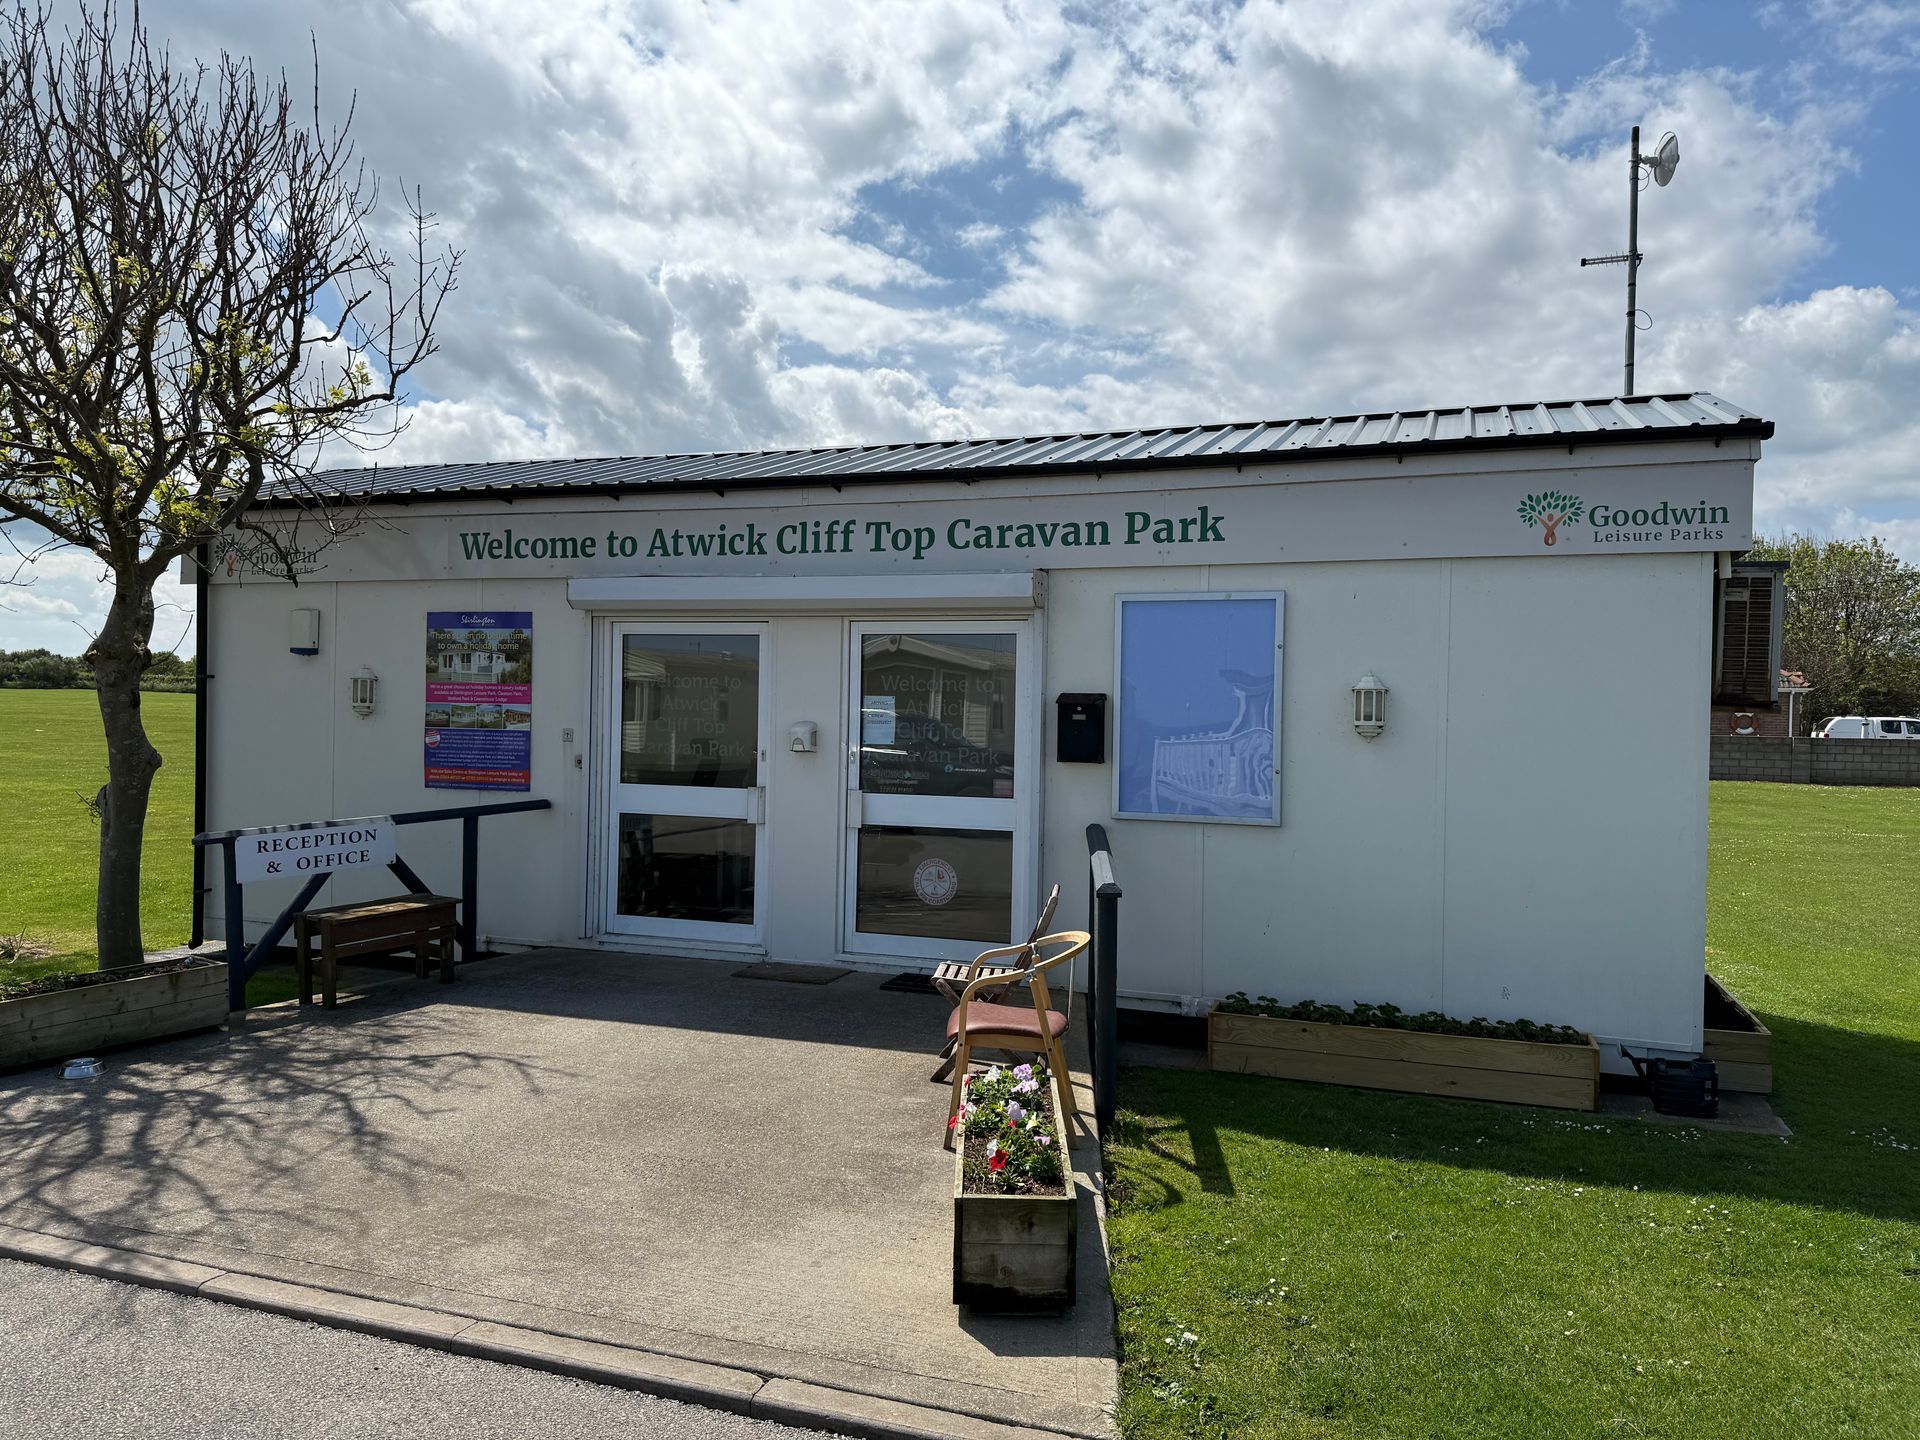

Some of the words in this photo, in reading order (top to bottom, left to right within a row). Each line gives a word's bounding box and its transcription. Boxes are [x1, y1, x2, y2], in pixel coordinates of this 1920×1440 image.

[1589, 500, 1730, 528] Goodwin
[460, 529, 596, 560] Welcome
[607, 530, 638, 558] to
[646, 524, 768, 558] Atwick
[776, 520, 857, 554] Cliff
[866, 520, 936, 560] Top
[947, 518, 1111, 550] Caravan
[1124, 505, 1226, 545] Park
[1593, 530, 1664, 544] Leisure
[1670, 527, 1724, 542] Parks
[288, 564, 314, 574] arks
[510, 632, 528, 640] time
[641, 673, 719, 688] elcome
[725, 675, 742, 689] to
[881, 675, 968, 692] Welcome
[976, 676, 994, 692] to
[693, 718, 726, 736] Top
[897, 720, 936, 739] Cliff
[940, 722, 971, 742] To
[710, 740, 746, 758] Park
[958, 747, 1000, 764] Park
[256, 828, 378, 854] RECEPTION
[266, 860, 282, 874] &
[296, 850, 370, 870] OFFICE
